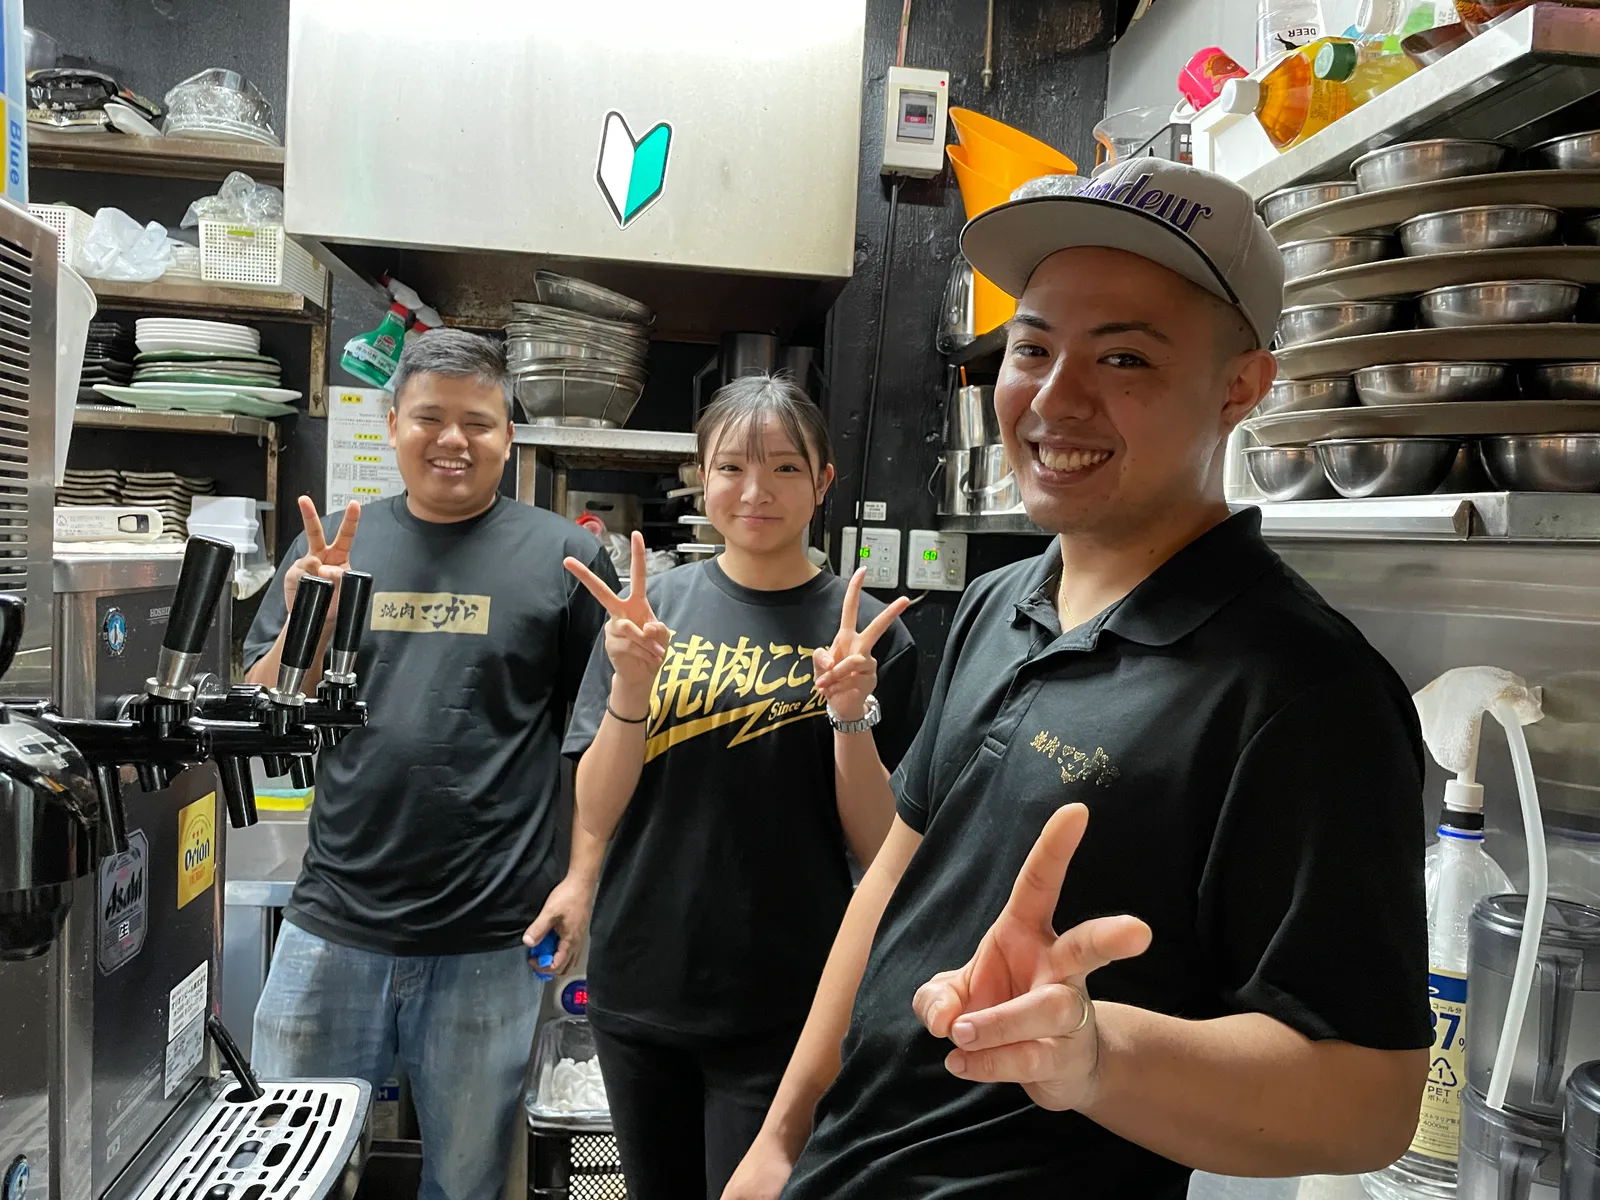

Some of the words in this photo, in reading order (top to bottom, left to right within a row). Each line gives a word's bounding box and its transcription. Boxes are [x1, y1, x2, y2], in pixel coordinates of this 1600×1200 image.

[1288, 27, 1316, 38] DEER
[10, 119, 22, 186] Blue
[1074, 173, 1213, 234] ndeur
[923, 550, 937, 561] 60
[647, 629, 830, 739] 焼肉ここ
[768, 700, 801, 721] Since
[184, 838, 210, 871] Orion
[104, 866, 143, 921] Asahi
[1428, 1085, 1451, 1097] PET
